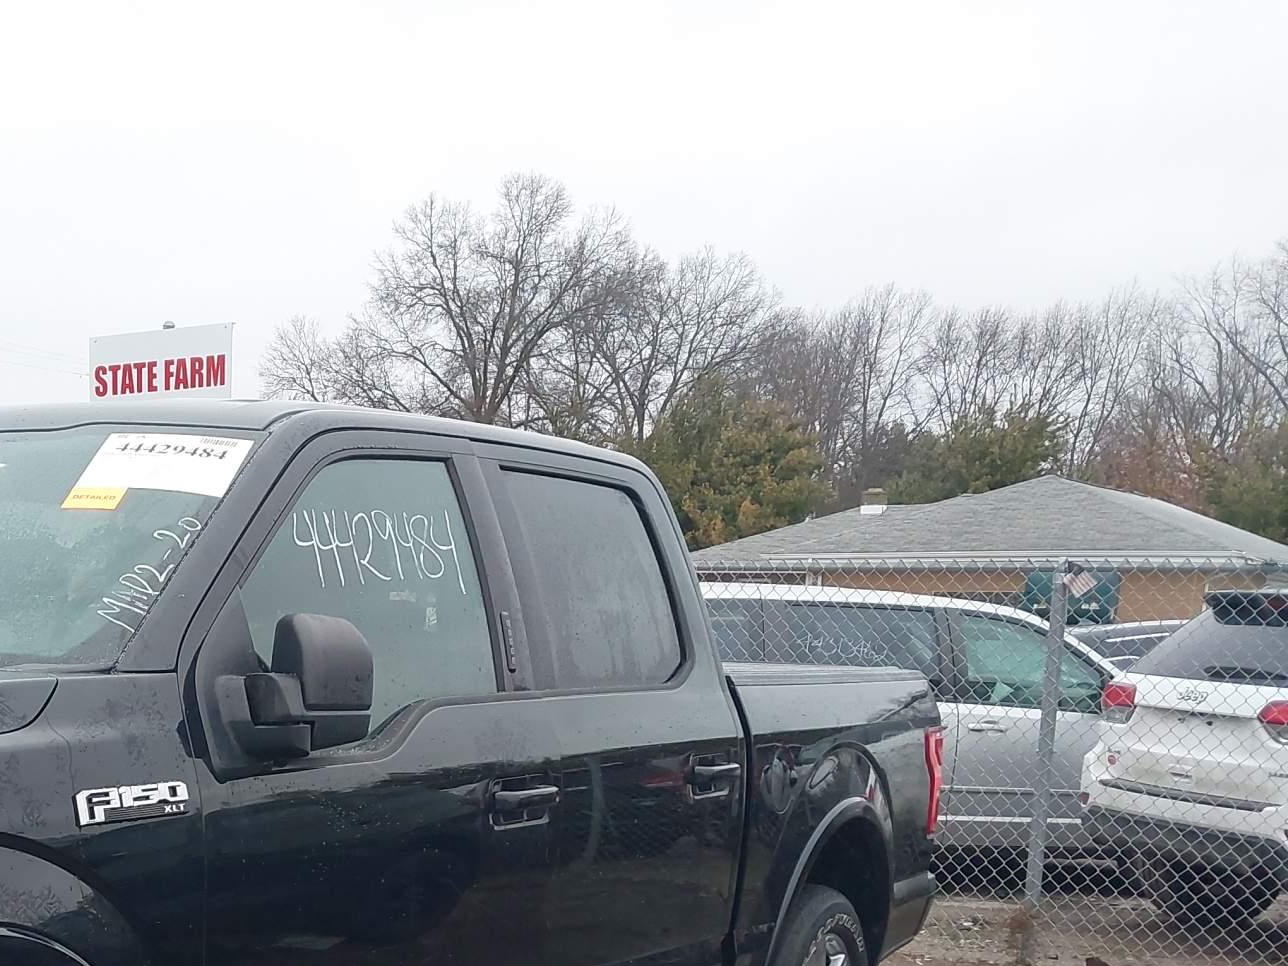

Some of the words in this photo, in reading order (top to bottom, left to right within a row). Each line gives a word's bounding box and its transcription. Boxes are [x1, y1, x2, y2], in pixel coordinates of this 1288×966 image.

[94, 360, 159, 398] STATE
[163, 353, 226, 391] FARM
[115, 441, 229, 460] 44429484
[71, 493, 117, 502] DETAILED
[292, 508, 467, 595] 44429484
[1176, 686, 1209, 705] Jeep
[163, 802, 186, 814] XLT
